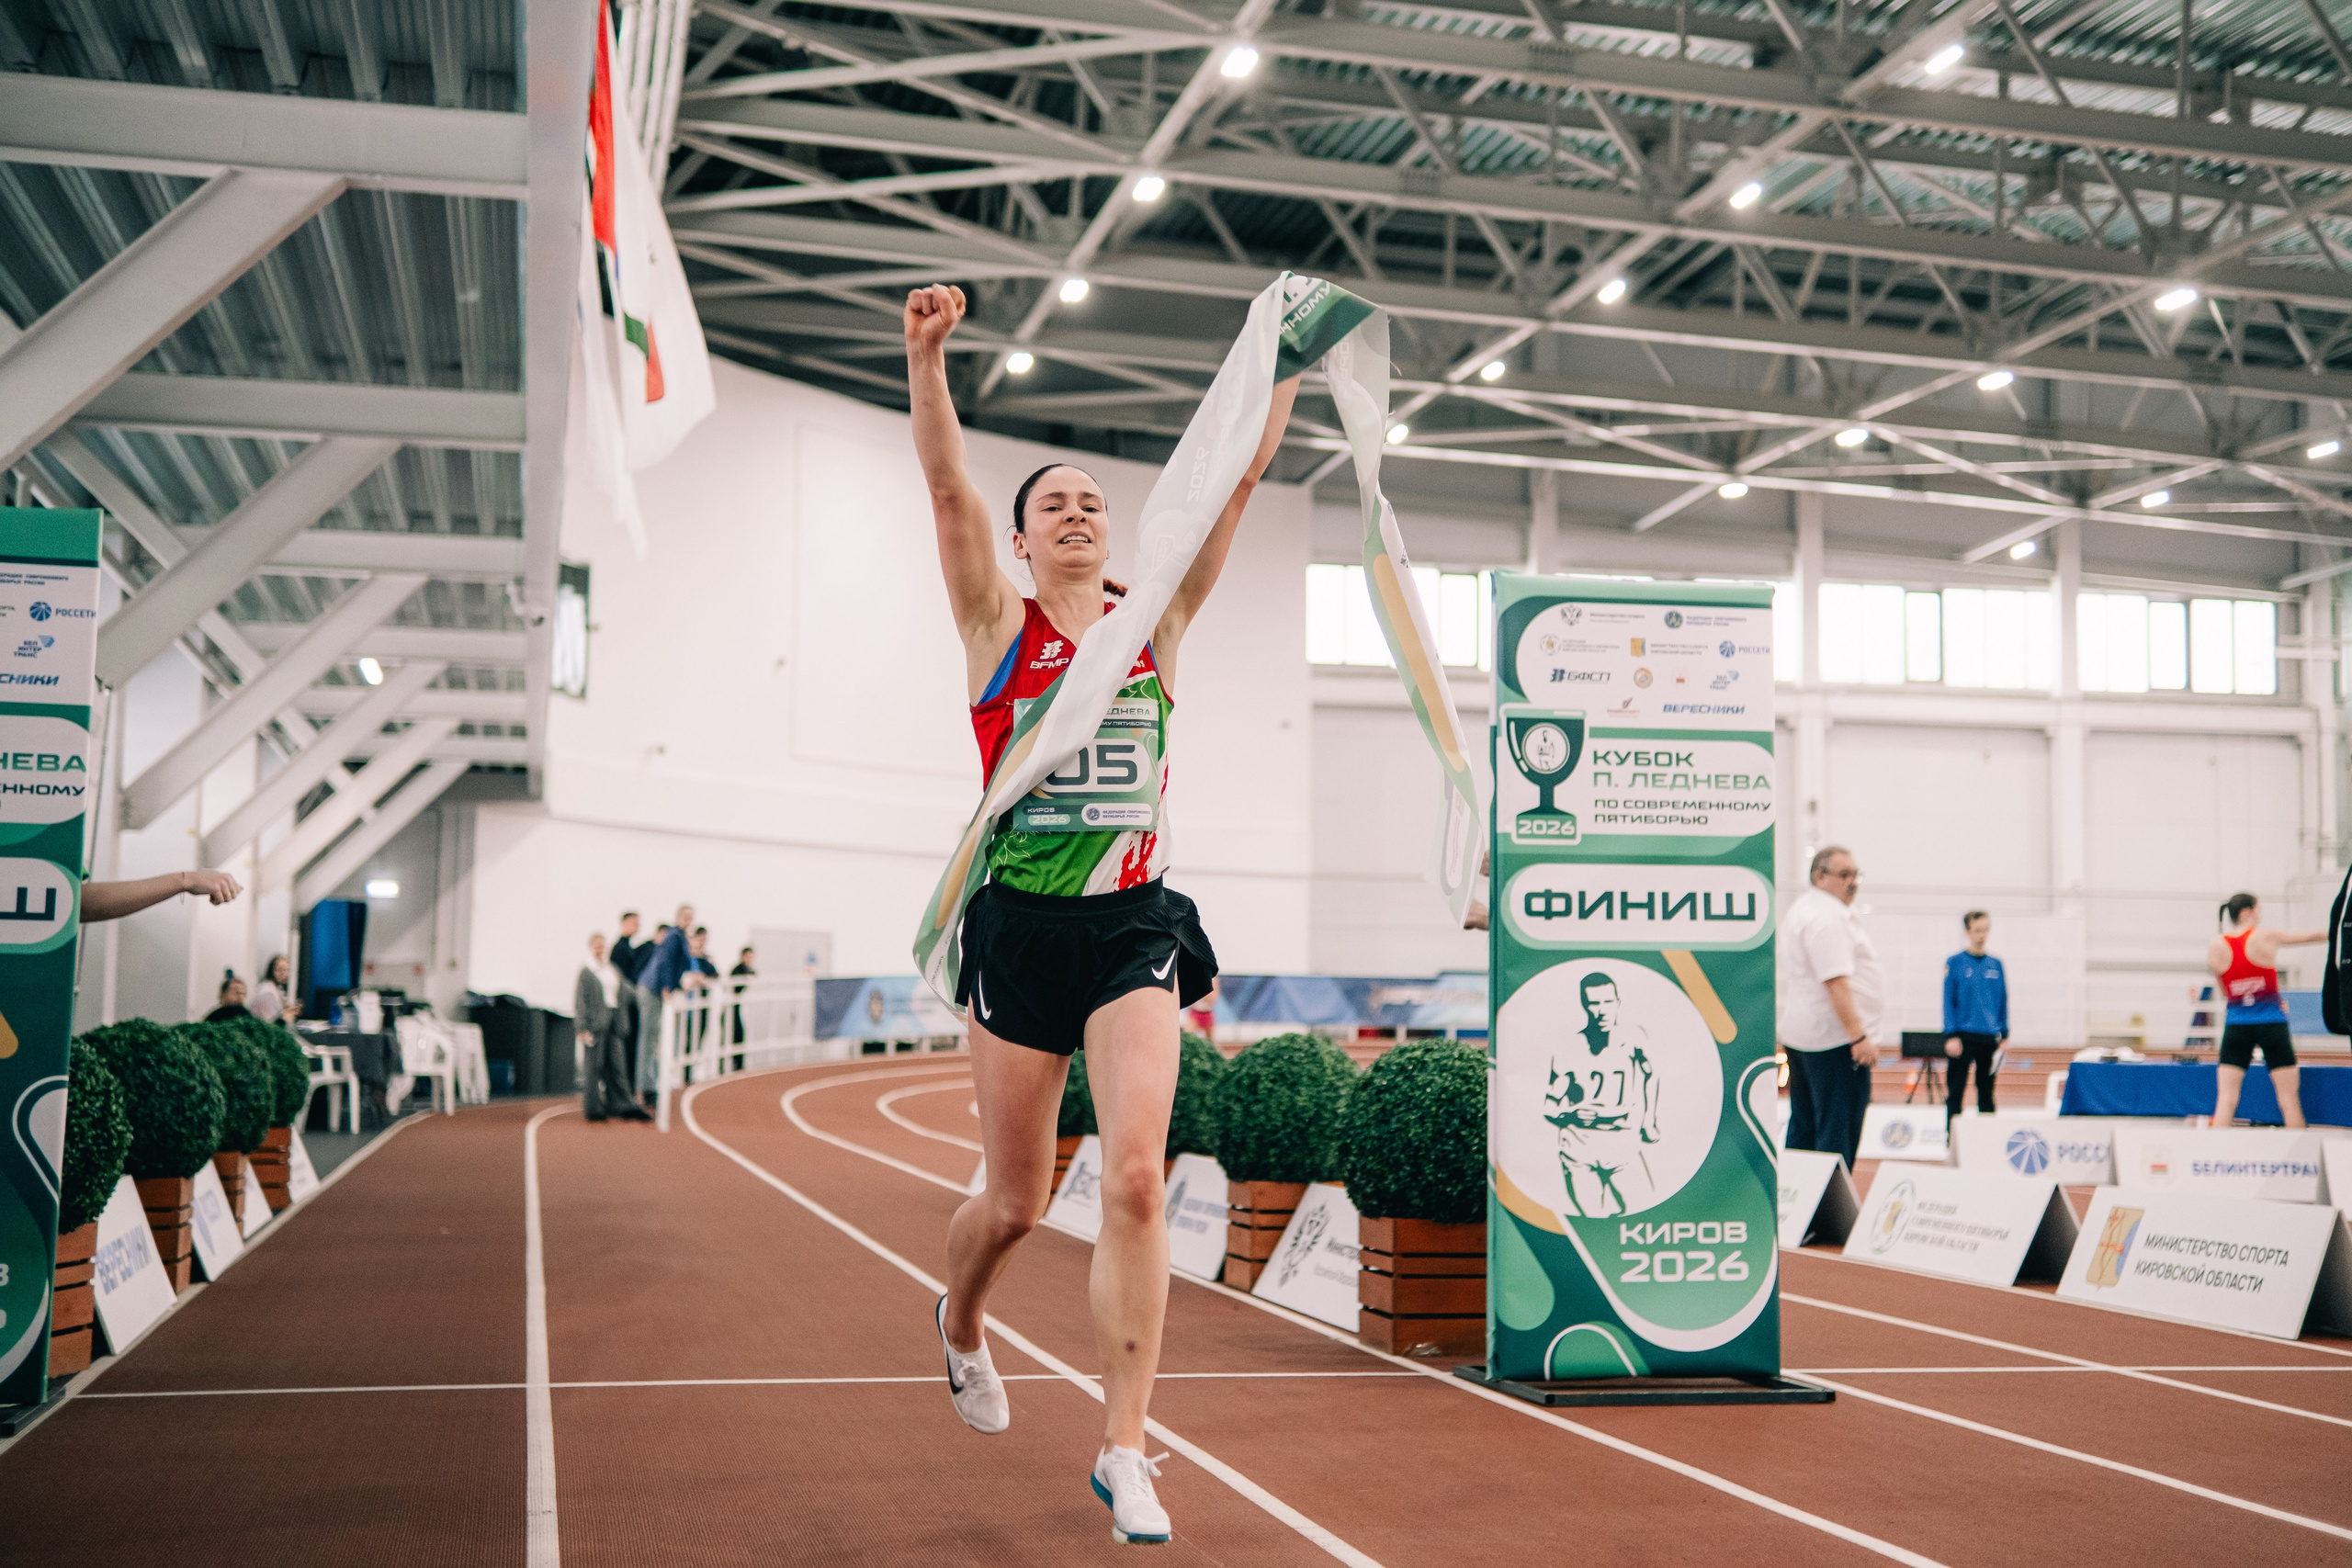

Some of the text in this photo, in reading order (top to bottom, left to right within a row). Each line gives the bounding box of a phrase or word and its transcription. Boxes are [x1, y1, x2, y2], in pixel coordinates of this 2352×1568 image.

[1280, 281, 1331, 333] ННОМУ
[1738, 646, 1770, 654] РОССЕТИ
[1030, 658, 1069, 669] BFMP
[0, 673, 60, 685] СНИКИ
[1567, 671, 1611, 682] БФСП
[1662, 704, 1746, 715] ВЕРЕСНИКИ
[1593, 750, 1694, 768] КУБОК
[1593, 772, 1772, 791] П. ЛЕДНЕВА
[0, 784, 85, 796] ННОМУ
[1594, 799, 1771, 811] ПО СОВРЕМЕННОМУ
[1032, 815, 1067, 824] 2026
[1594, 814, 1709, 825] ПЯТИБОРЬЮ
[1518, 819, 1576, 835] 2026
[1524, 888, 1756, 921] ФИНИШ
[1620, 1221, 1747, 1245] КИРОВ
[2143, 1234, 2290, 1269] МИНИСТЕРСТВО СПОРТА
[1620, 1250, 1749, 1283] 2026
[2133, 1259, 2265, 1293] КИРОВСКОЙ ОБЛАСТИ
